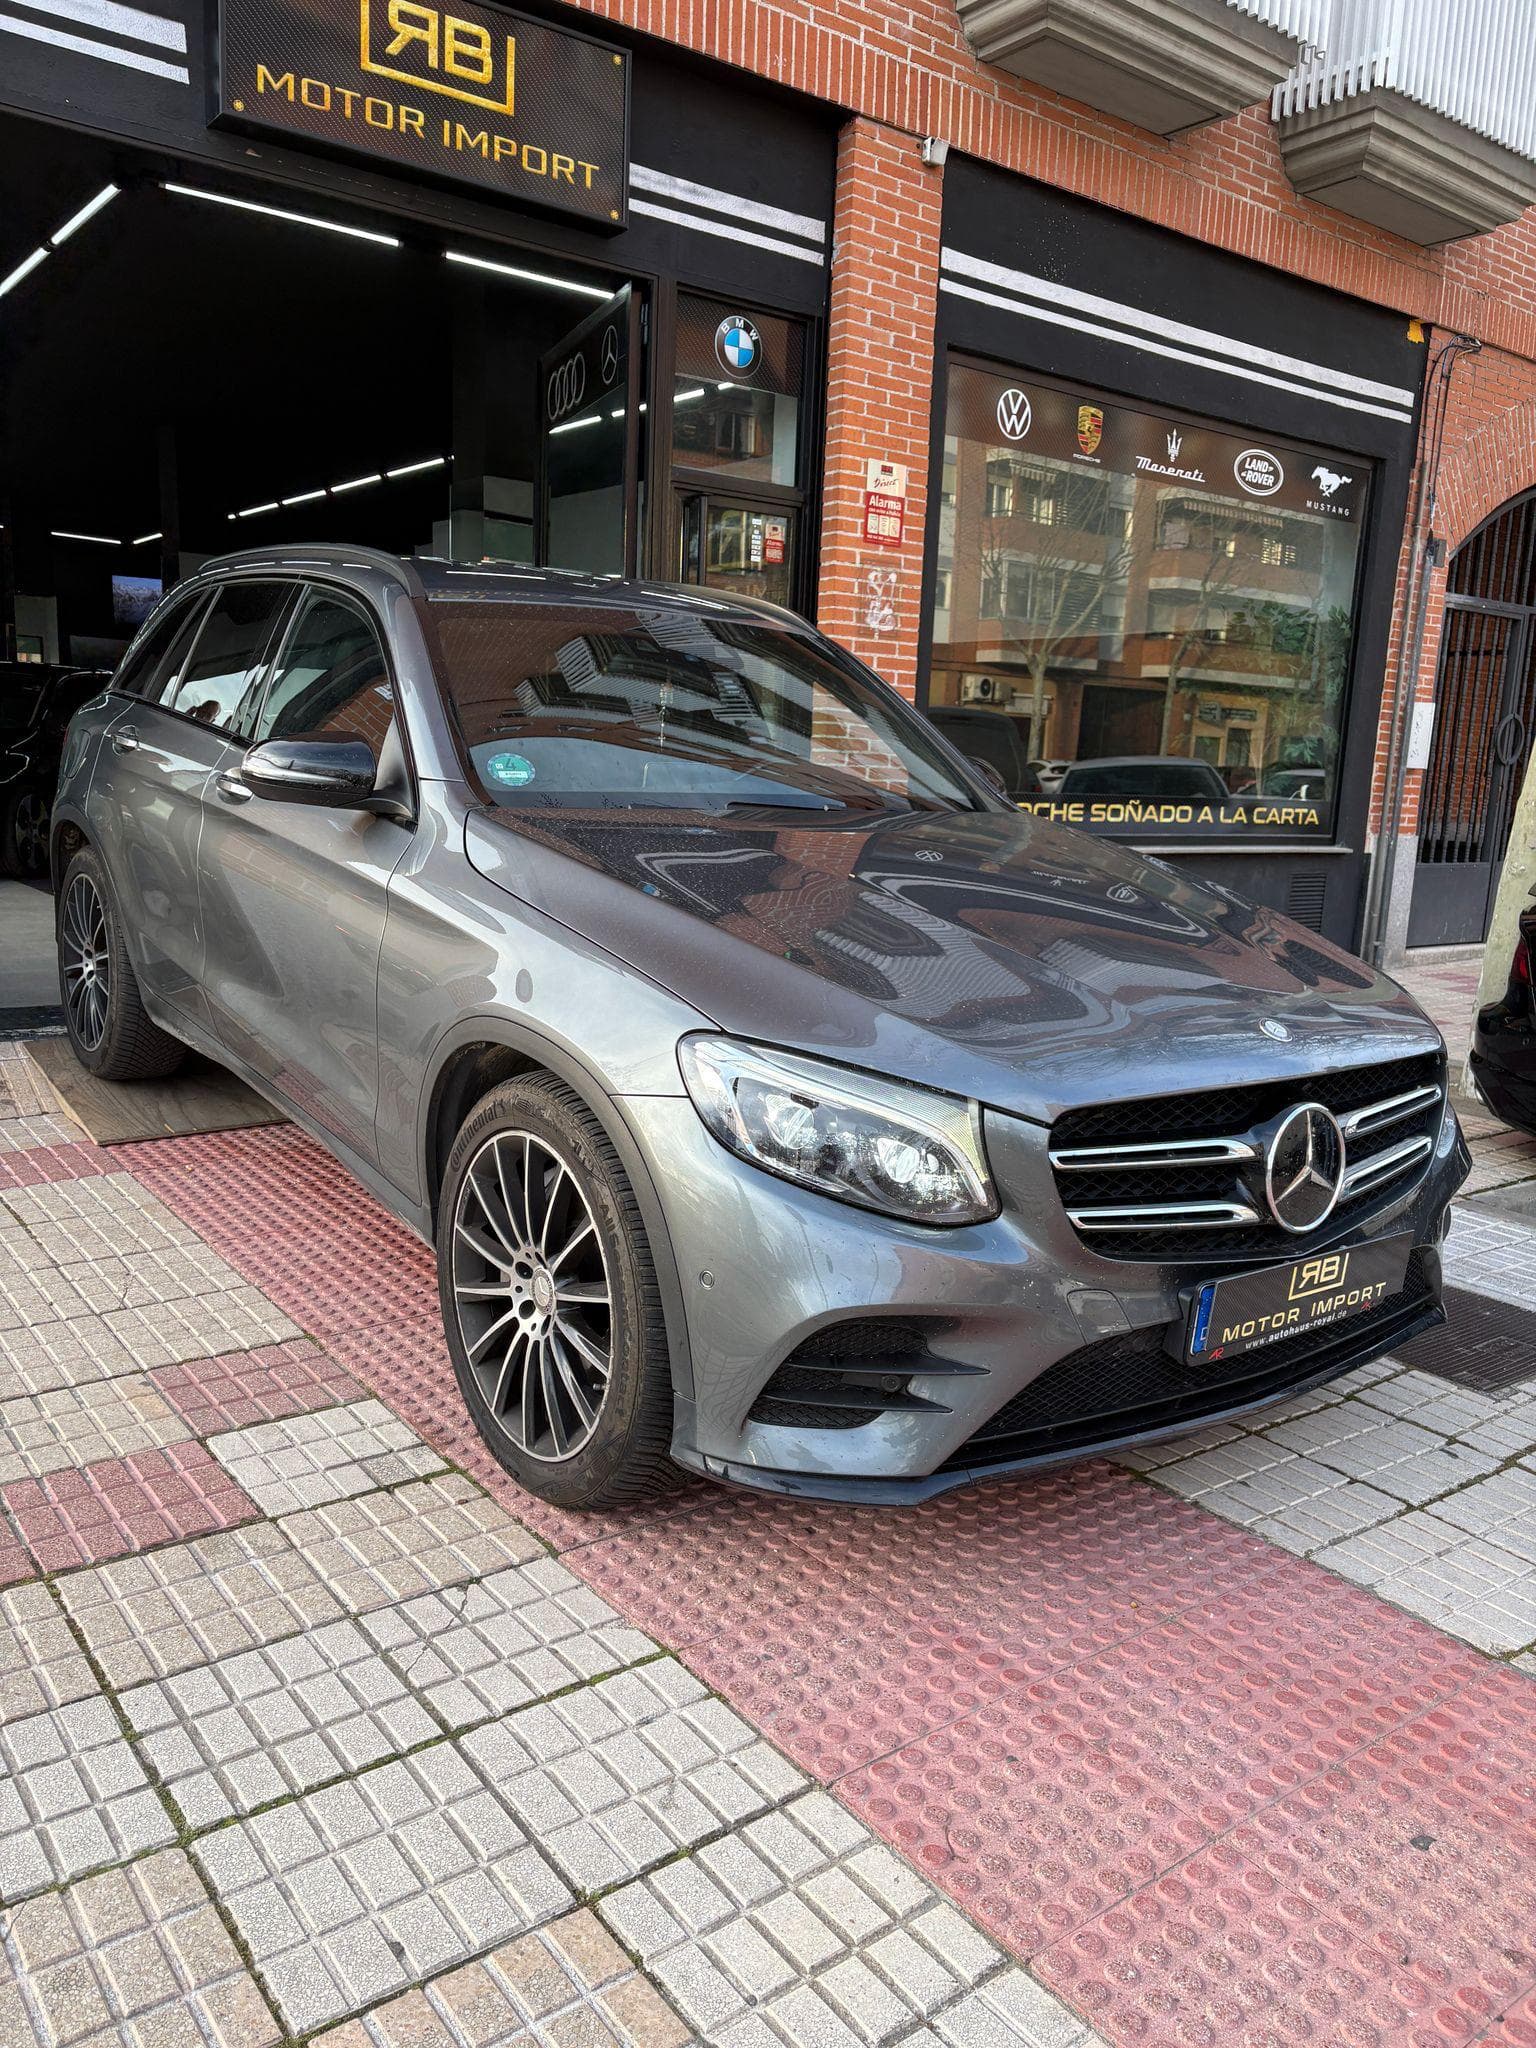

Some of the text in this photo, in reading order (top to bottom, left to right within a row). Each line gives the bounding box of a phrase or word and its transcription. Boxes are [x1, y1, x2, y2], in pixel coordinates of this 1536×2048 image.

[256, 63, 601, 190] MOTOR IMPORT
[720, 317, 760, 341] BMW
[1135, 455, 1206, 483] Maserati
[1244, 457, 1270, 473] LAND
[1245, 470, 1275, 487] ROVER
[869, 494, 902, 511] Alarma
[1306, 500, 1350, 517] MUSTANG
[1090, 800, 1193, 824] SOÑADO
[1196, 805, 1215, 824] A
[1219, 806, 1248, 825] LA
[1252, 806, 1320, 826] CARTA
[1222, 1281, 1387, 1343] MOTOR IMPORT
[1245, 1309, 1348, 1349] www.autohaus-royal.de
